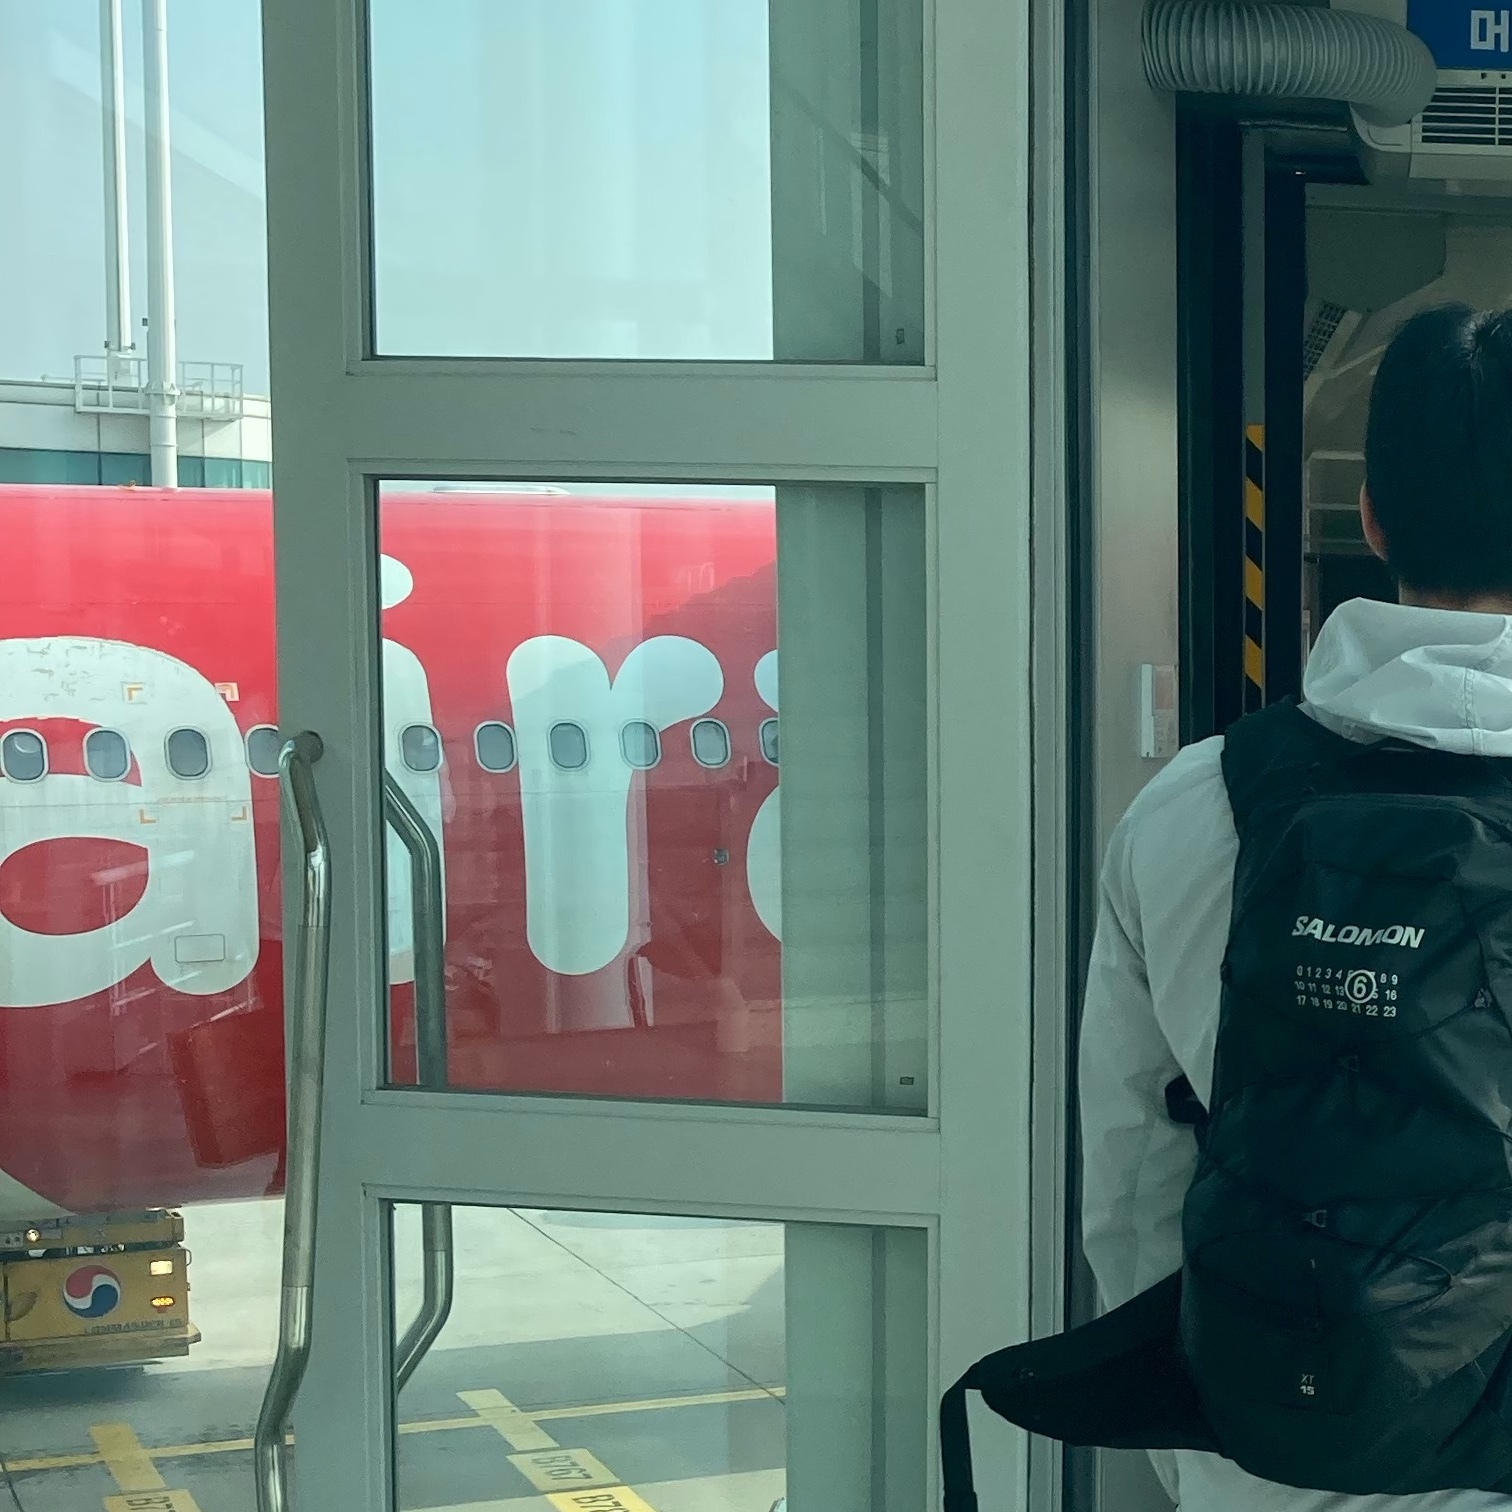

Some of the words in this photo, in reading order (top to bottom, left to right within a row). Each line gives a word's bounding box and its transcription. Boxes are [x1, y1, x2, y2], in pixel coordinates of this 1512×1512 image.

[1291, 915, 1426, 949] SALOMON
[1294, 980, 1305, 990] 10
[1308, 982, 1317, 992] 11
[1321, 983, 1331, 994] 12
[1334, 985, 1345, 996] 13
[1385, 989, 1397, 1001] 16
[1306, 966, 1312, 978] 1
[1315, 967, 1322, 978] 2
[1325, 968, 1332, 979] 3
[1335, 969, 1343, 980] 4
[1352, 975, 1368, 998] 6
[1379, 972, 1387, 983] 8
[1391, 974, 1398, 985] 9
[1296, 995, 1306, 1005] 17
[1310, 997, 1320, 1007] 18
[1323, 998, 1333, 1009] 19
[1336, 1000, 1348, 1010] 20
[1351, 1003, 1361, 1014] 21
[1365, 1004, 1379, 1016] 22
[1383, 1006, 1397, 1018] 23
[1301, 1373, 1314, 1384] XT
[531, 1455, 593, 1480] B767
